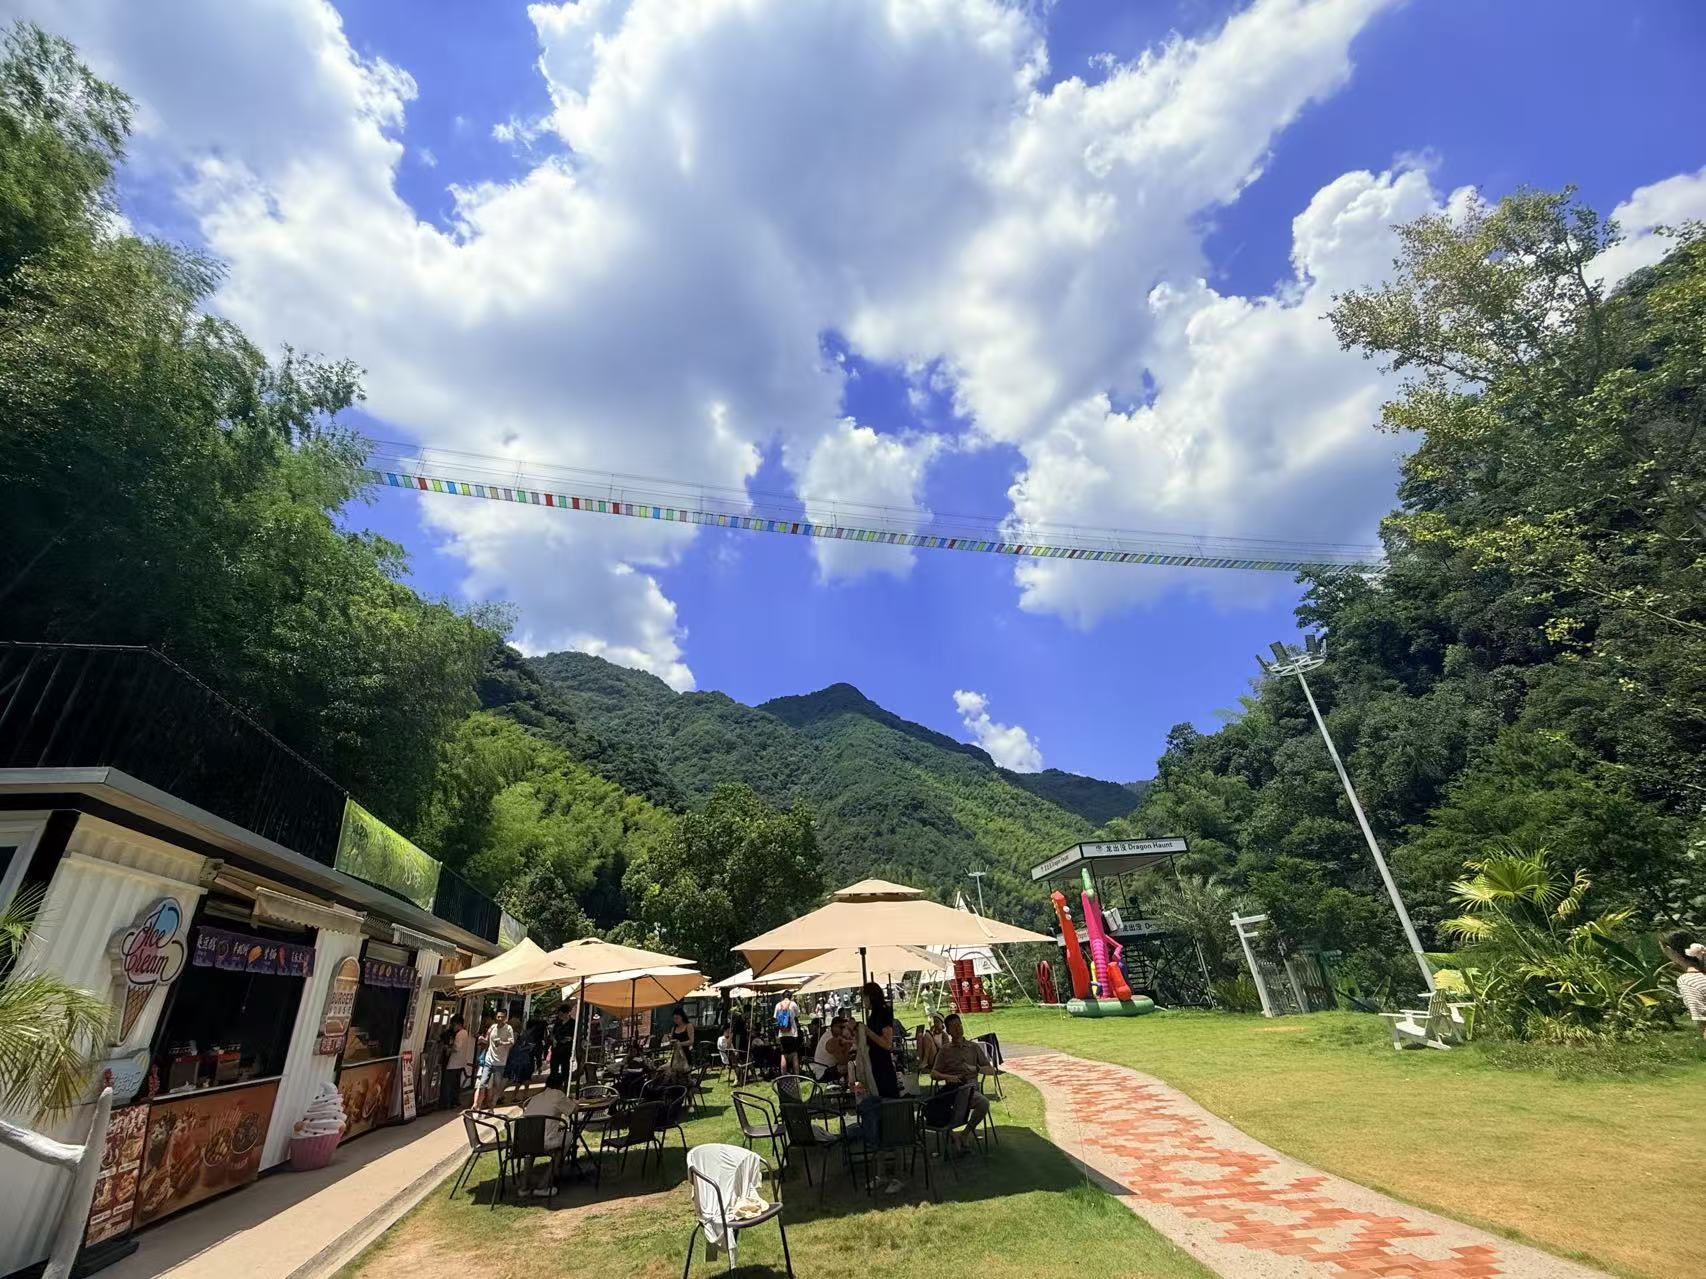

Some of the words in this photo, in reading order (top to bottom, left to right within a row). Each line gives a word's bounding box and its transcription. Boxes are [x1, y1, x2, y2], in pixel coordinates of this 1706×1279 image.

[1128, 842, 1152, 852] Dragon
[1152, 840, 1173, 849] Haunt
[330, 992, 354, 1006] BURGER
